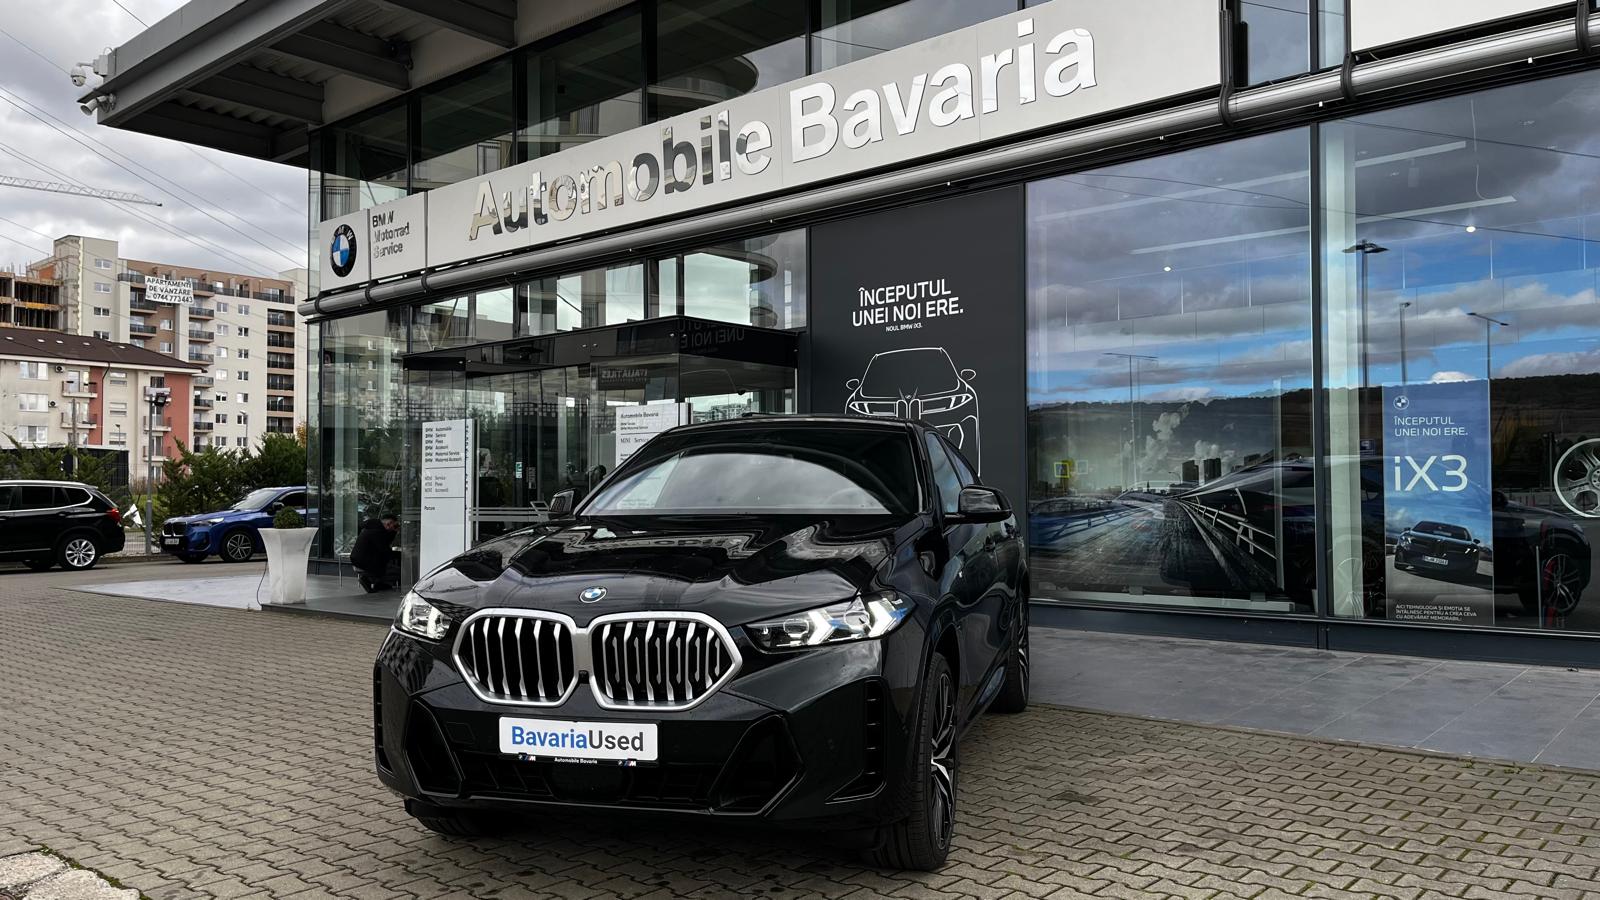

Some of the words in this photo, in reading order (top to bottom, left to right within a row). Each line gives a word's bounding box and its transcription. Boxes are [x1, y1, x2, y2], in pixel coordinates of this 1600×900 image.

[469, 109, 773, 241] Automobile
[789, 18, 1097, 163] Bavaria
[372, 211, 394, 227] BMW
[374, 222, 409, 242] Motorrad
[374, 242, 403, 258] Service
[858, 279, 952, 307] ÎNCEPUTUL
[852, 307, 888, 327] UNEI
[893, 302, 921, 322] NOI
[926, 296, 964, 318] ERE.
[1394, 416, 1455, 425] ÎNCEPUTUL
[1394, 428, 1419, 436] UNEI
[1423, 428, 1440, 436] NOI
[1444, 427, 1469, 436] ERE.
[1394, 454, 1468, 491] iX3
[511, 726, 644, 751] BavariaUsed
